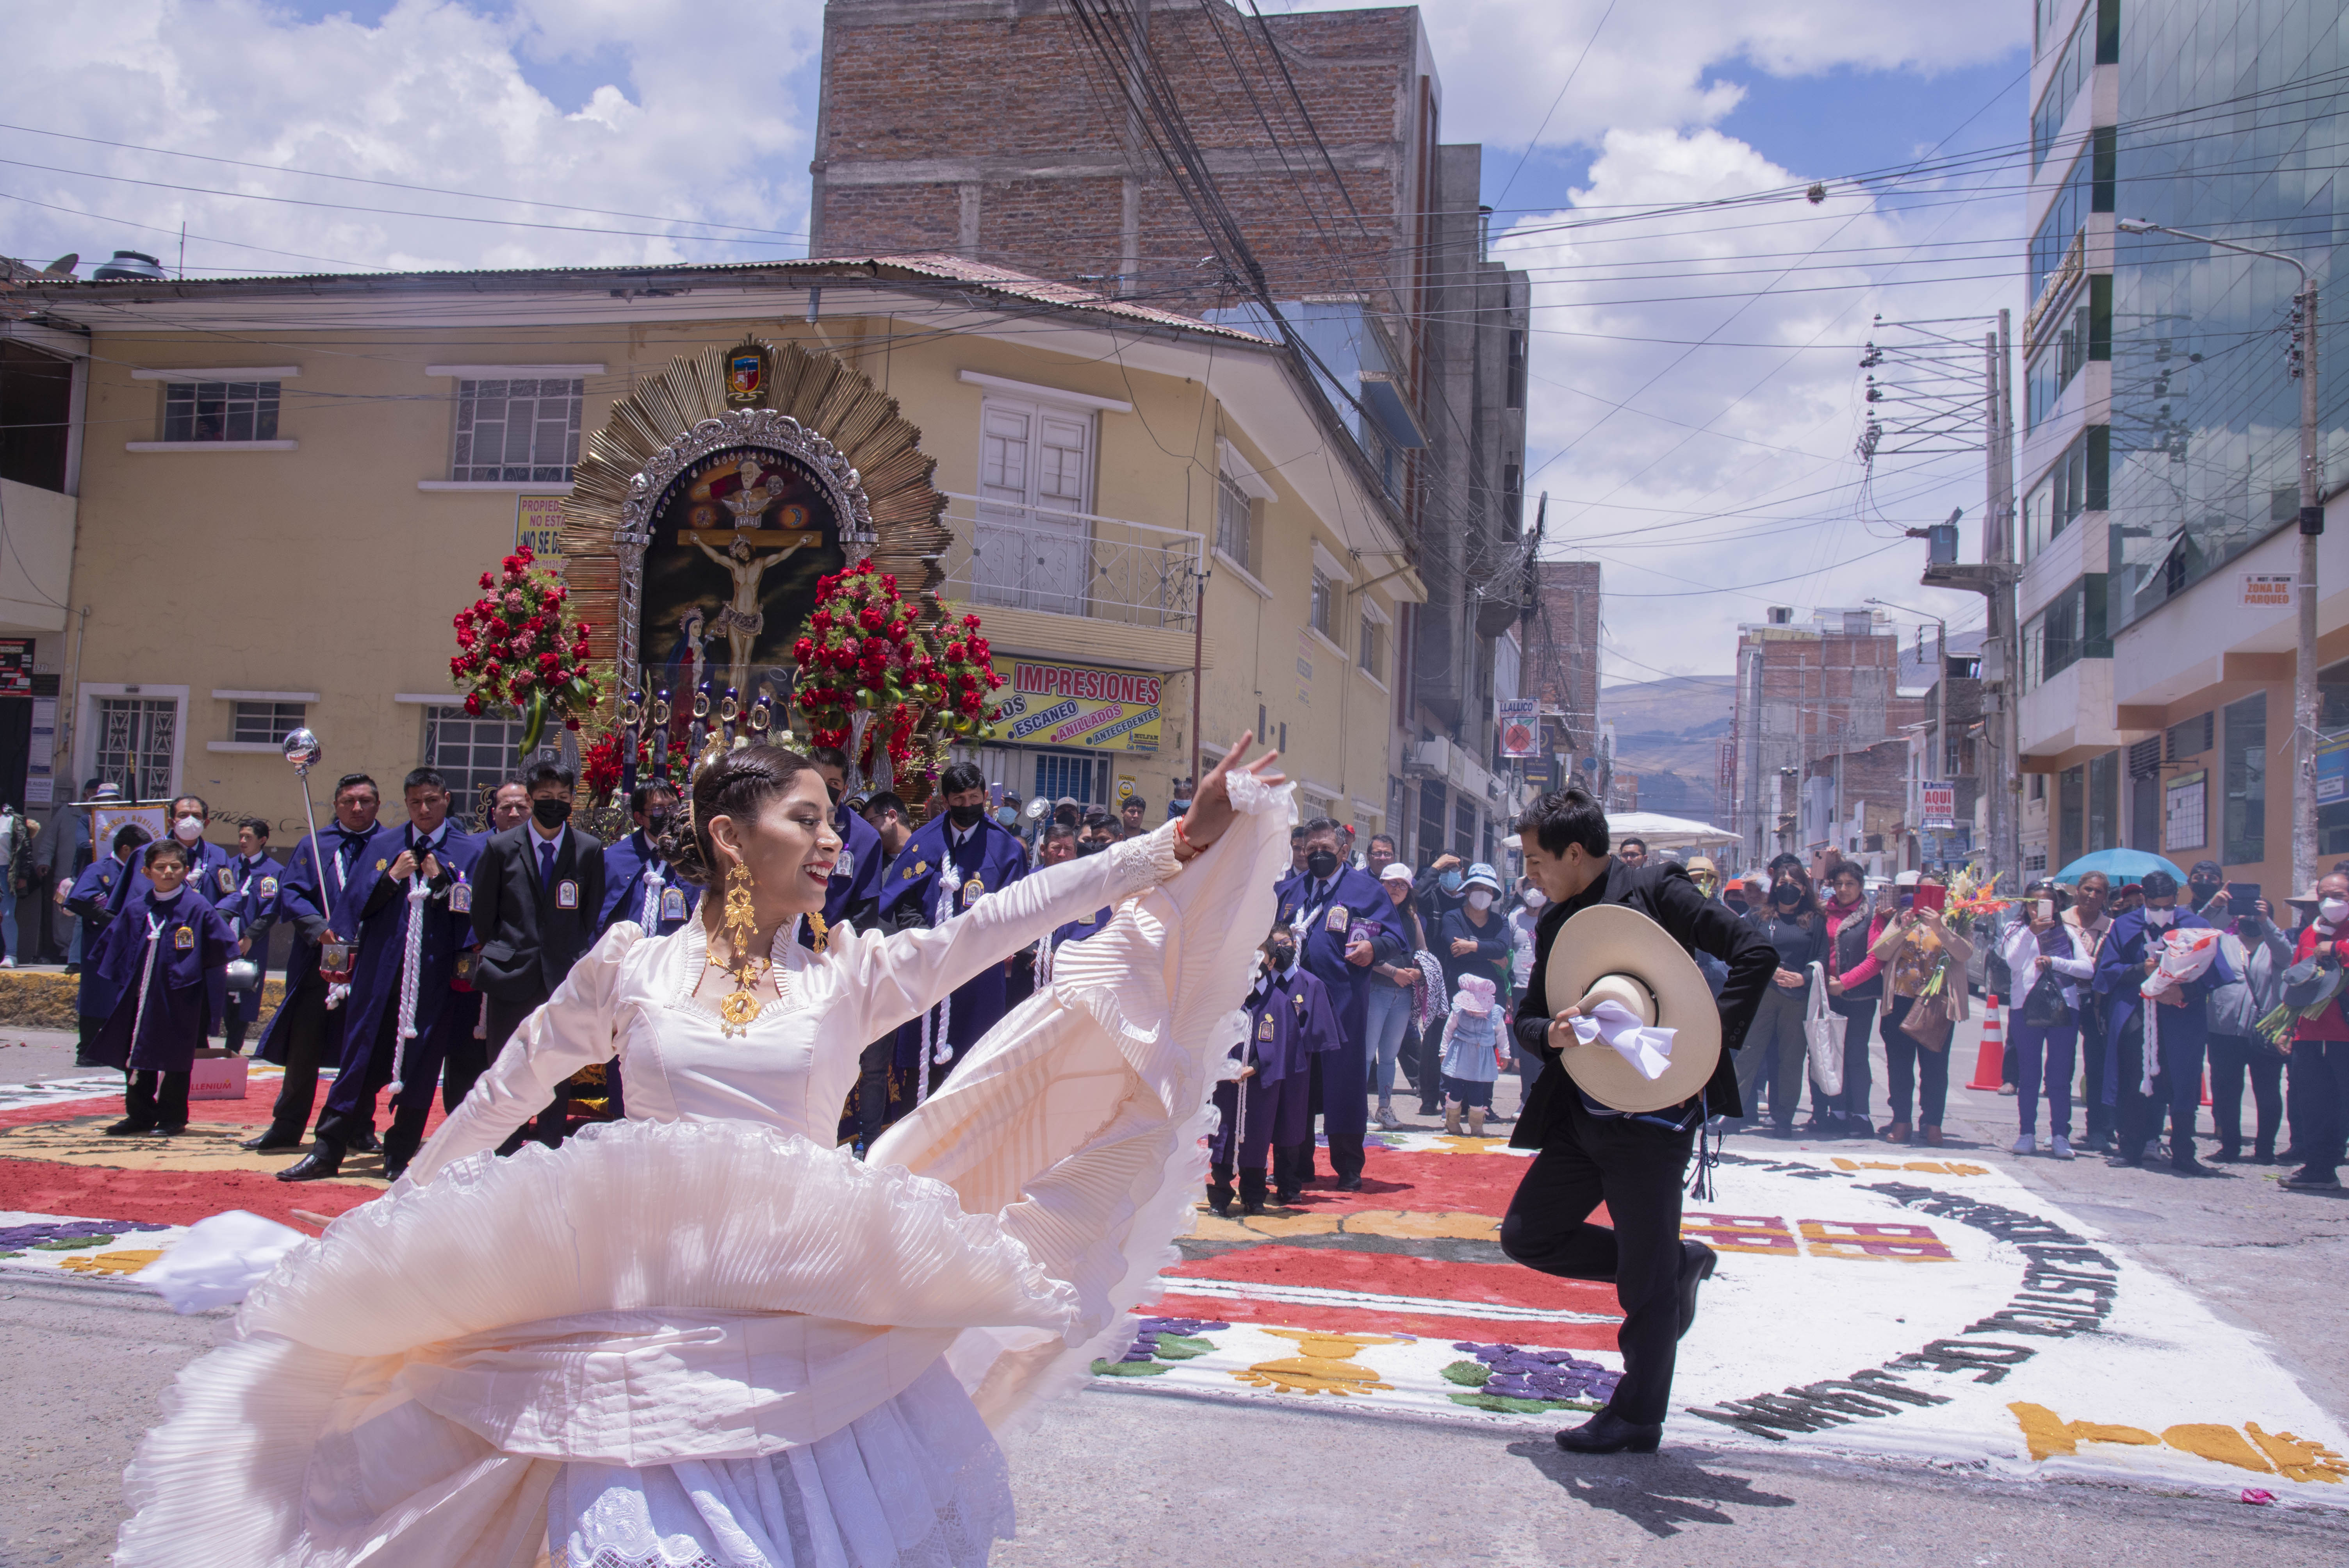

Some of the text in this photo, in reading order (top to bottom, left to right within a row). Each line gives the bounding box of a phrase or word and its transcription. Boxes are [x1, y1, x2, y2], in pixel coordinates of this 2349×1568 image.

[529, 515, 567, 527] NO ESTA
[740, 516, 757, 525] INRI
[538, 531, 550, 554] SE
[2244, 594, 2289, 604] PARQUEO
[2247, 583, 2287, 593] ZONA DE
[1015, 663, 1161, 707] IMPRESIONES
[1500, 702, 1533, 712] LLALLICO
[1014, 700, 1078, 738] ESCANEO
[1057, 703, 1123, 742] ANILLADOS
[1093, 707, 1160, 745] ANTECEDENTES
[1925, 789, 1951, 804] AQUÍ
[100, 814, 161, 842] PRIMEROS AUXILIOS
[1884, 1339, 2036, 1384] DE
